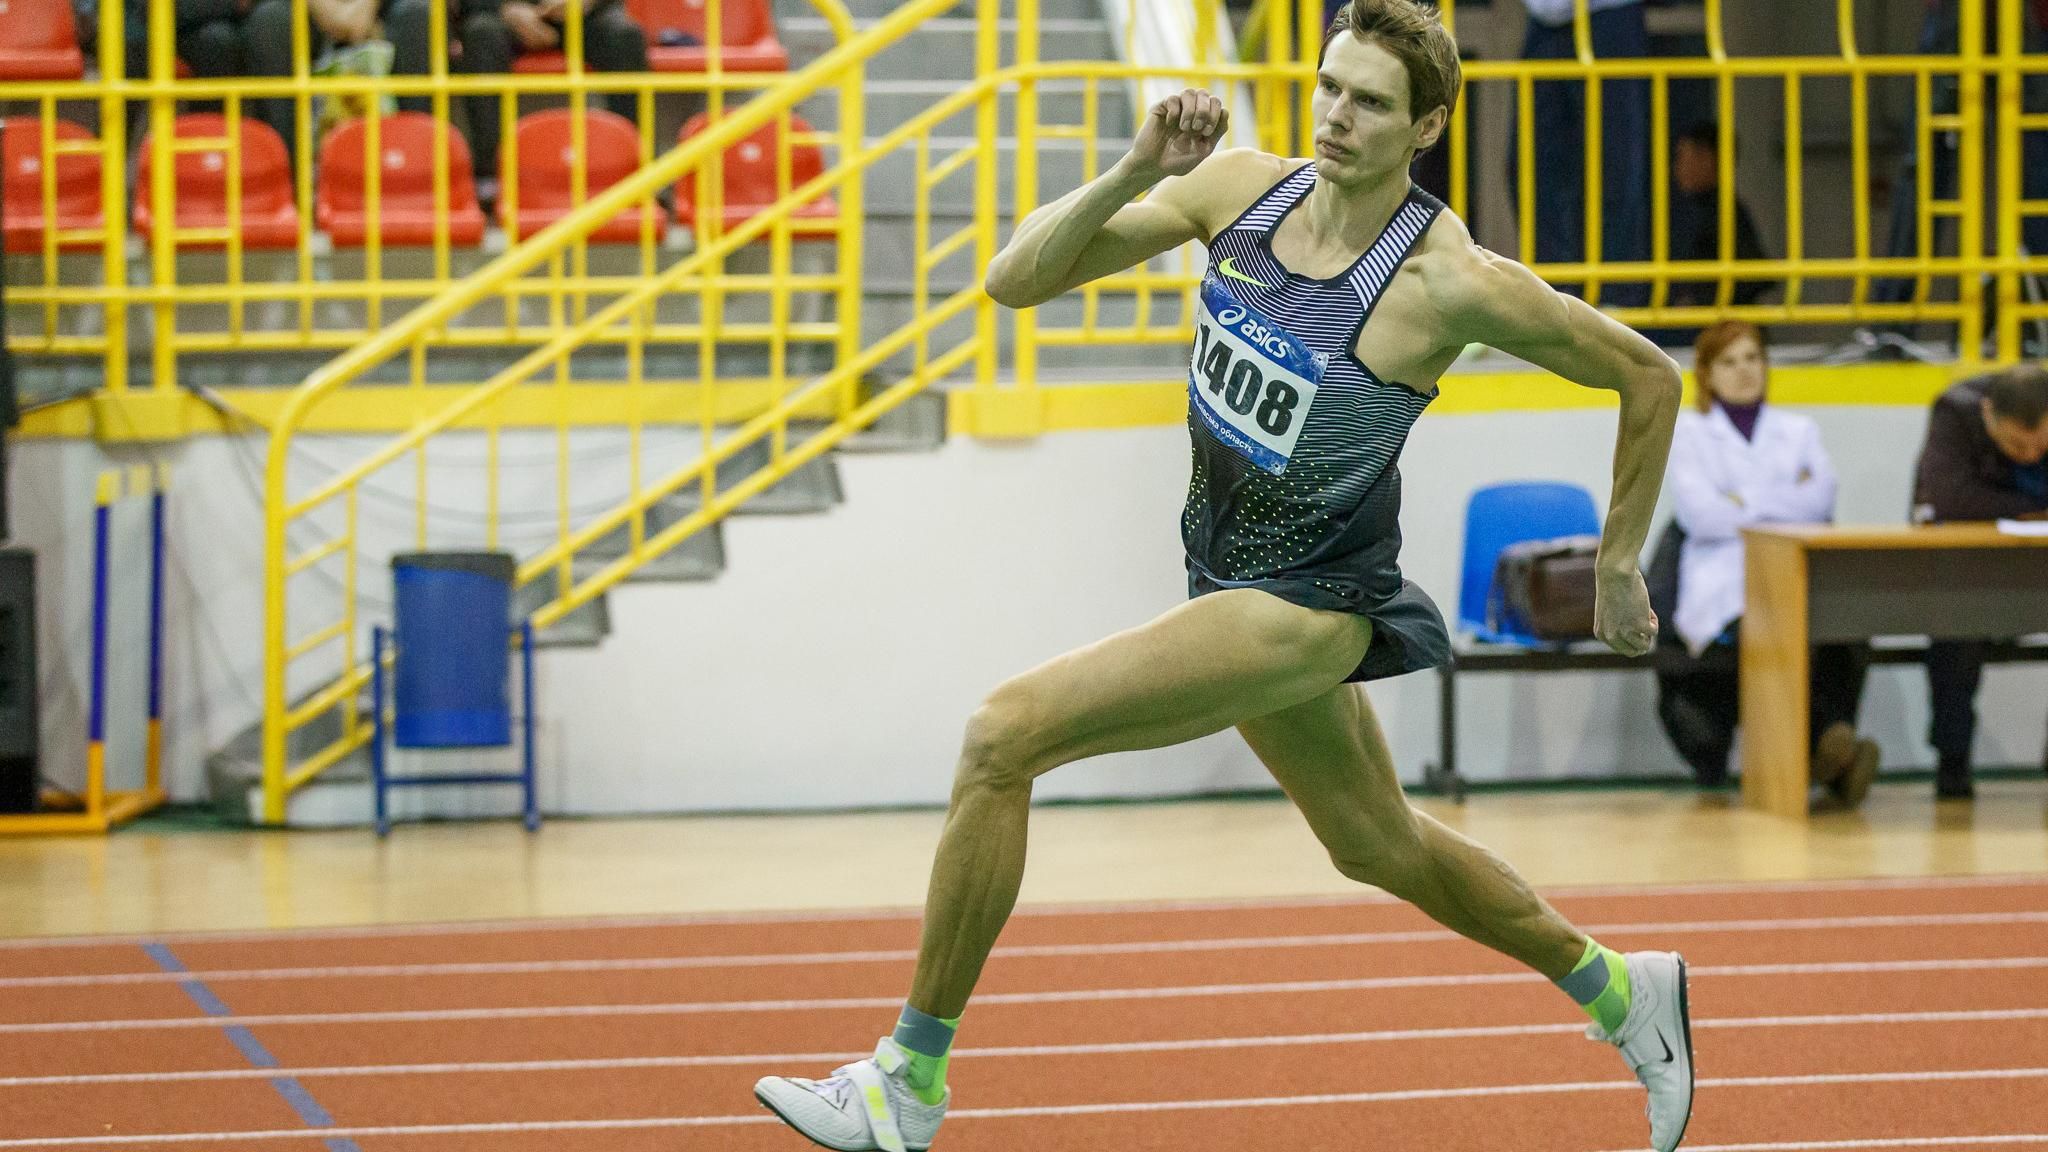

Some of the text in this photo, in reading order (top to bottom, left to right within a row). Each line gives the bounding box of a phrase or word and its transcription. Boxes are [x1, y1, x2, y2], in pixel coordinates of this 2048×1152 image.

[1240, 318, 1290, 358] asics
[1197, 323, 1299, 436] 1408
[1220, 426, 1254, 454] область
